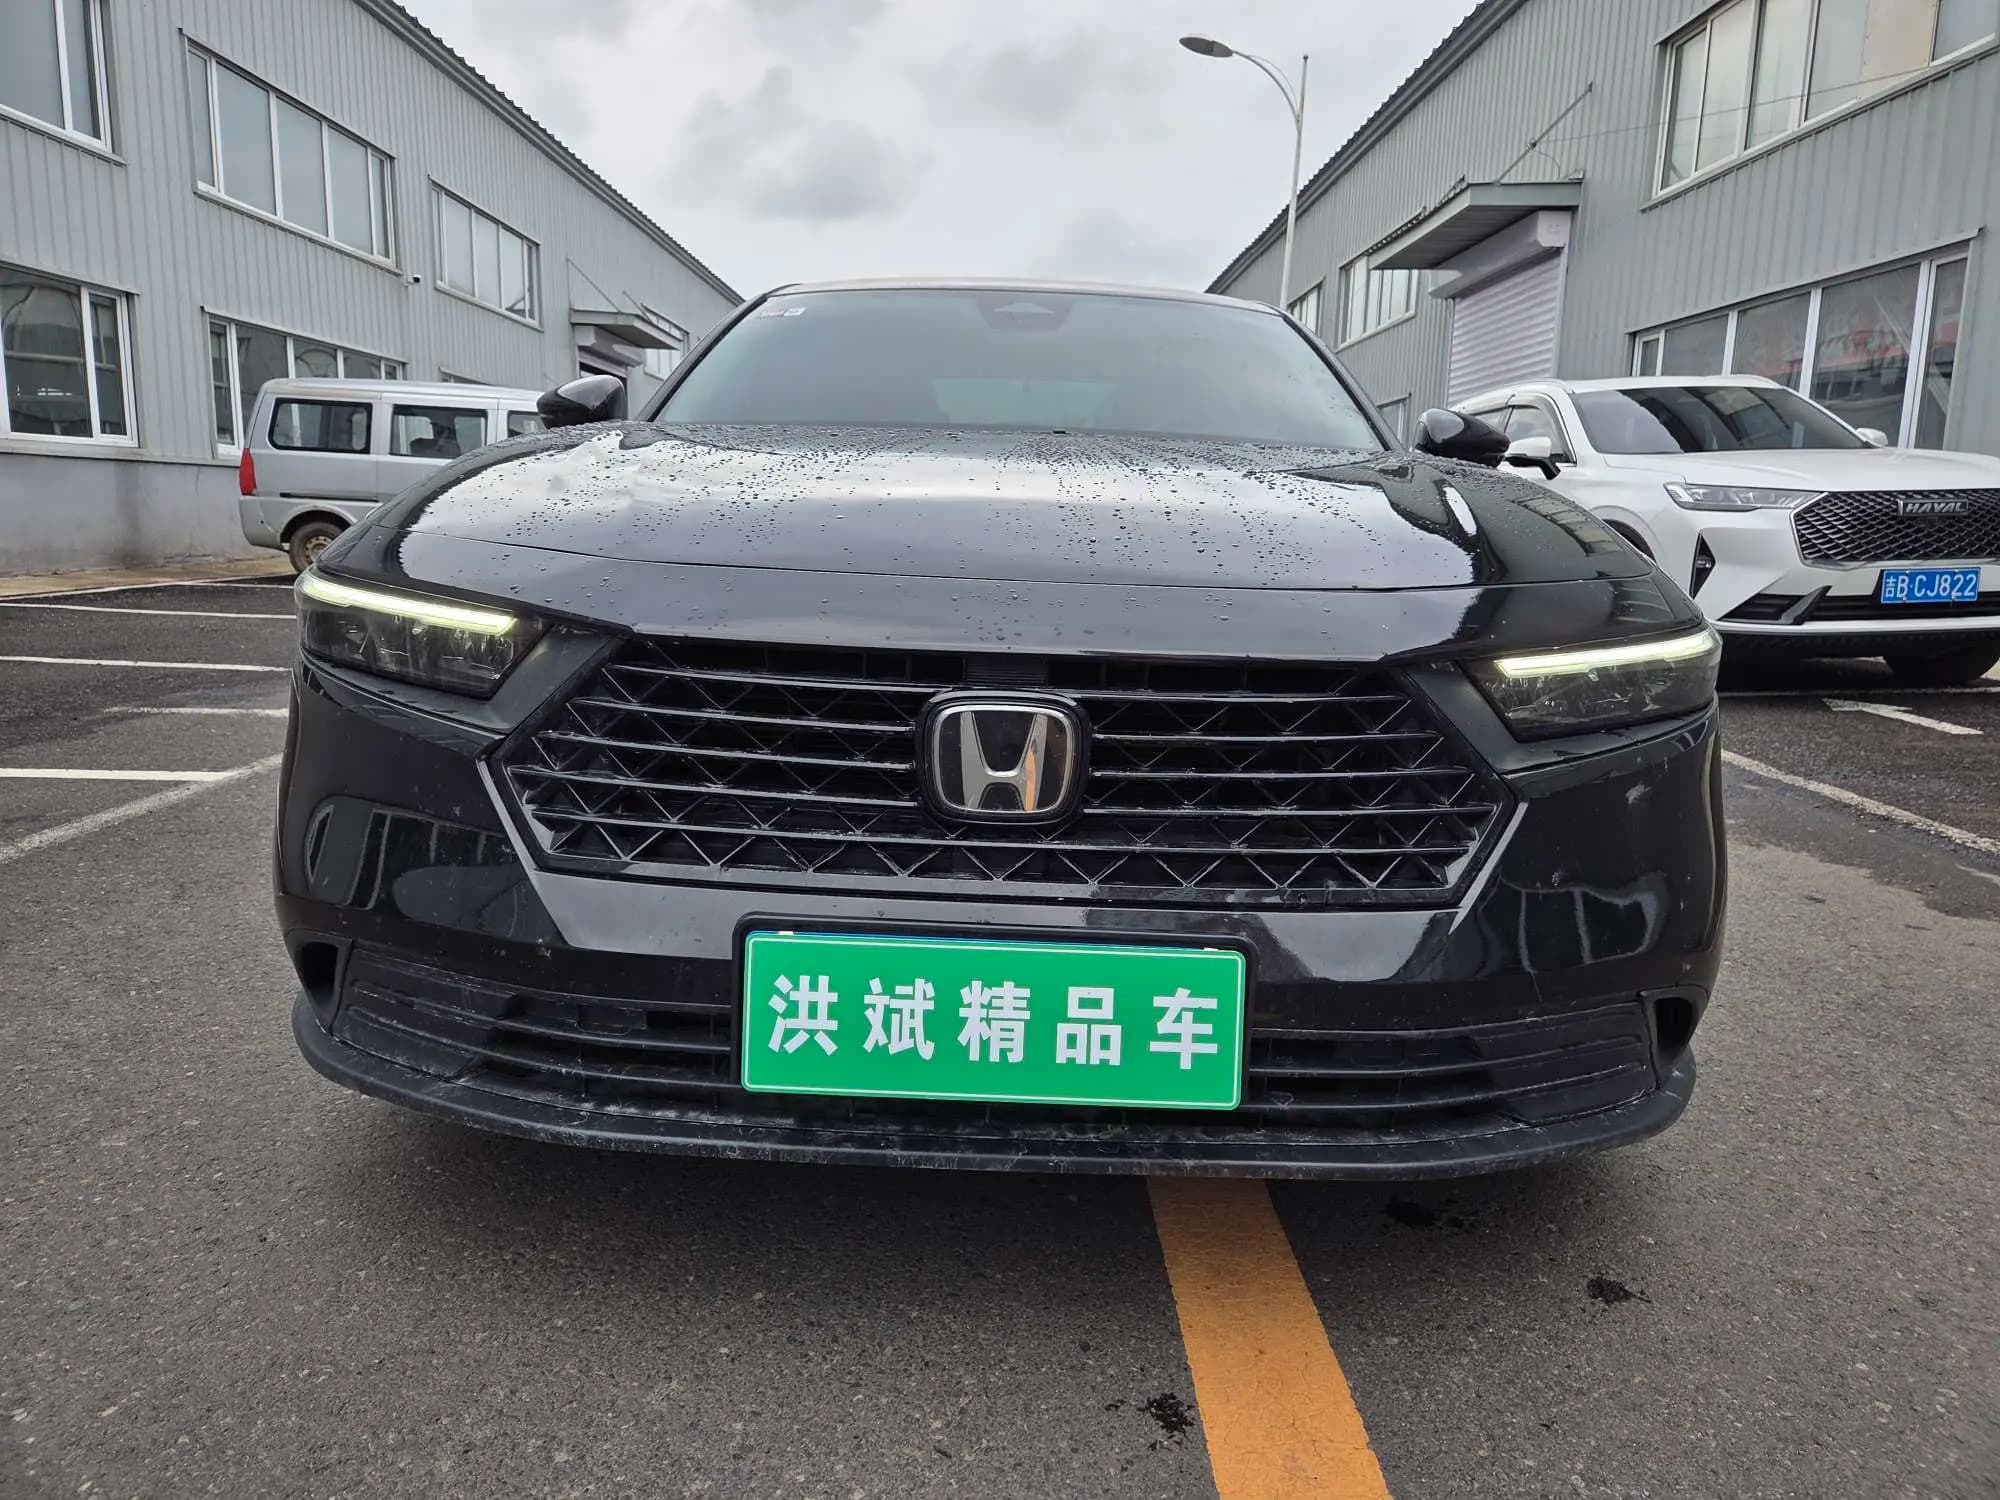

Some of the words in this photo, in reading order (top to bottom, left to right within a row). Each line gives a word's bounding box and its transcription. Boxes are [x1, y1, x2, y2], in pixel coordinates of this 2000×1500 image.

[1905, 502, 1965, 514] HAVAL
[768, 974, 1218, 1070] 洪斌精品车
